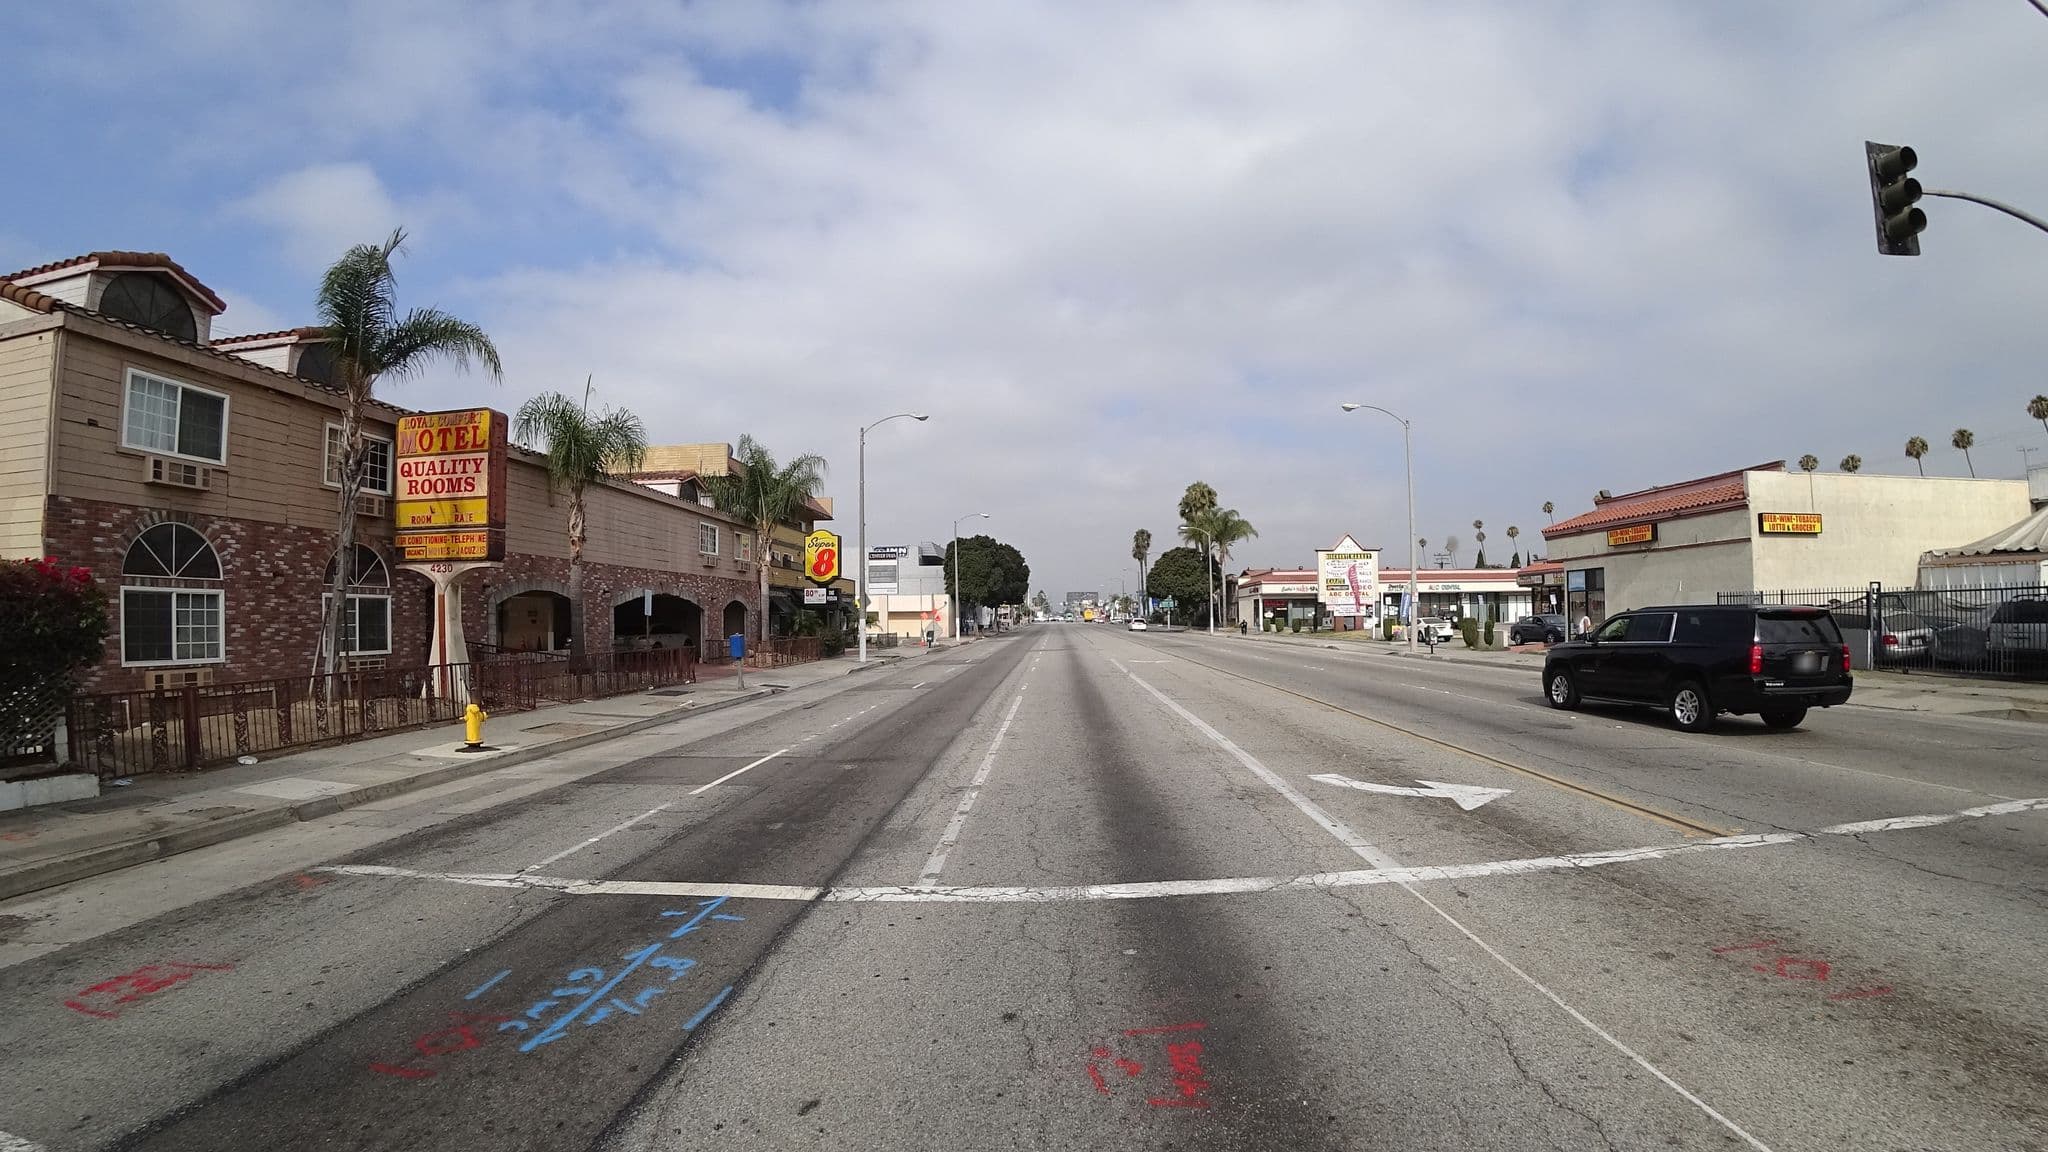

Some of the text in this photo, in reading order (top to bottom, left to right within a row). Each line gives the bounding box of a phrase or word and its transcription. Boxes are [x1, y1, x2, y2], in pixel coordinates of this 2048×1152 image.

[400, 425, 487, 454] MOTEL
[400, 458, 485, 478] QUALITY
[407, 476, 476, 495] ROOMS
[411, 515, 432, 525] ROOM
[808, 537, 836, 553] Super
[431, 564, 453, 573] 4230
[812, 548, 836, 577] 8
